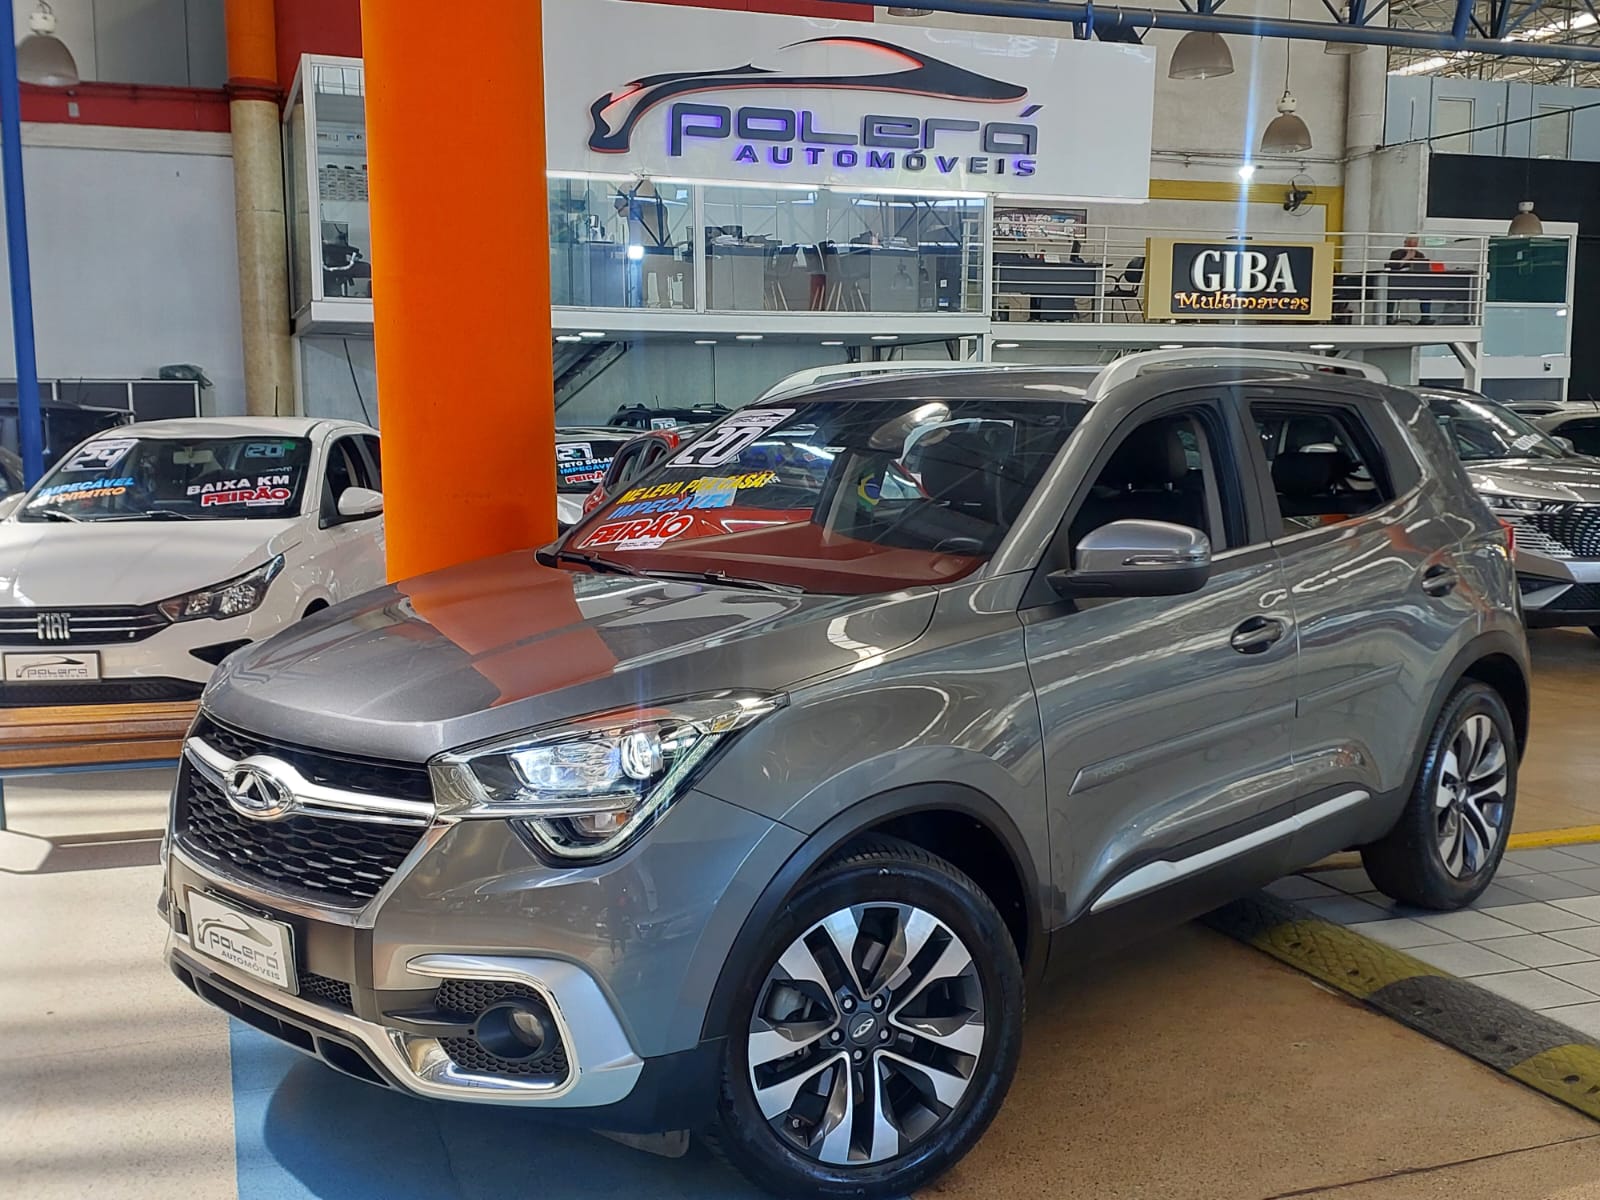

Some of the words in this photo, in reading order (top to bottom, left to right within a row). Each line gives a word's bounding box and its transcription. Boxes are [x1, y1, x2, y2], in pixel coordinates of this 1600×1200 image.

[736, 143, 1038, 176] AUTOMÓVEIS
[1191, 249, 1297, 293] GIBA
[1174, 291, 1309, 311] Multimarcas
[558, 447, 592, 461] 21
[673, 427, 763, 465] 20
[558, 459, 583, 469] TETO
[187, 478, 251, 496] BAIXA
[257, 475, 290, 486] KM
[641, 481, 685, 499] LEVA
[37, 612, 71, 640] FIAT
[221, 950, 281, 980] AUTOMÓVEIS
